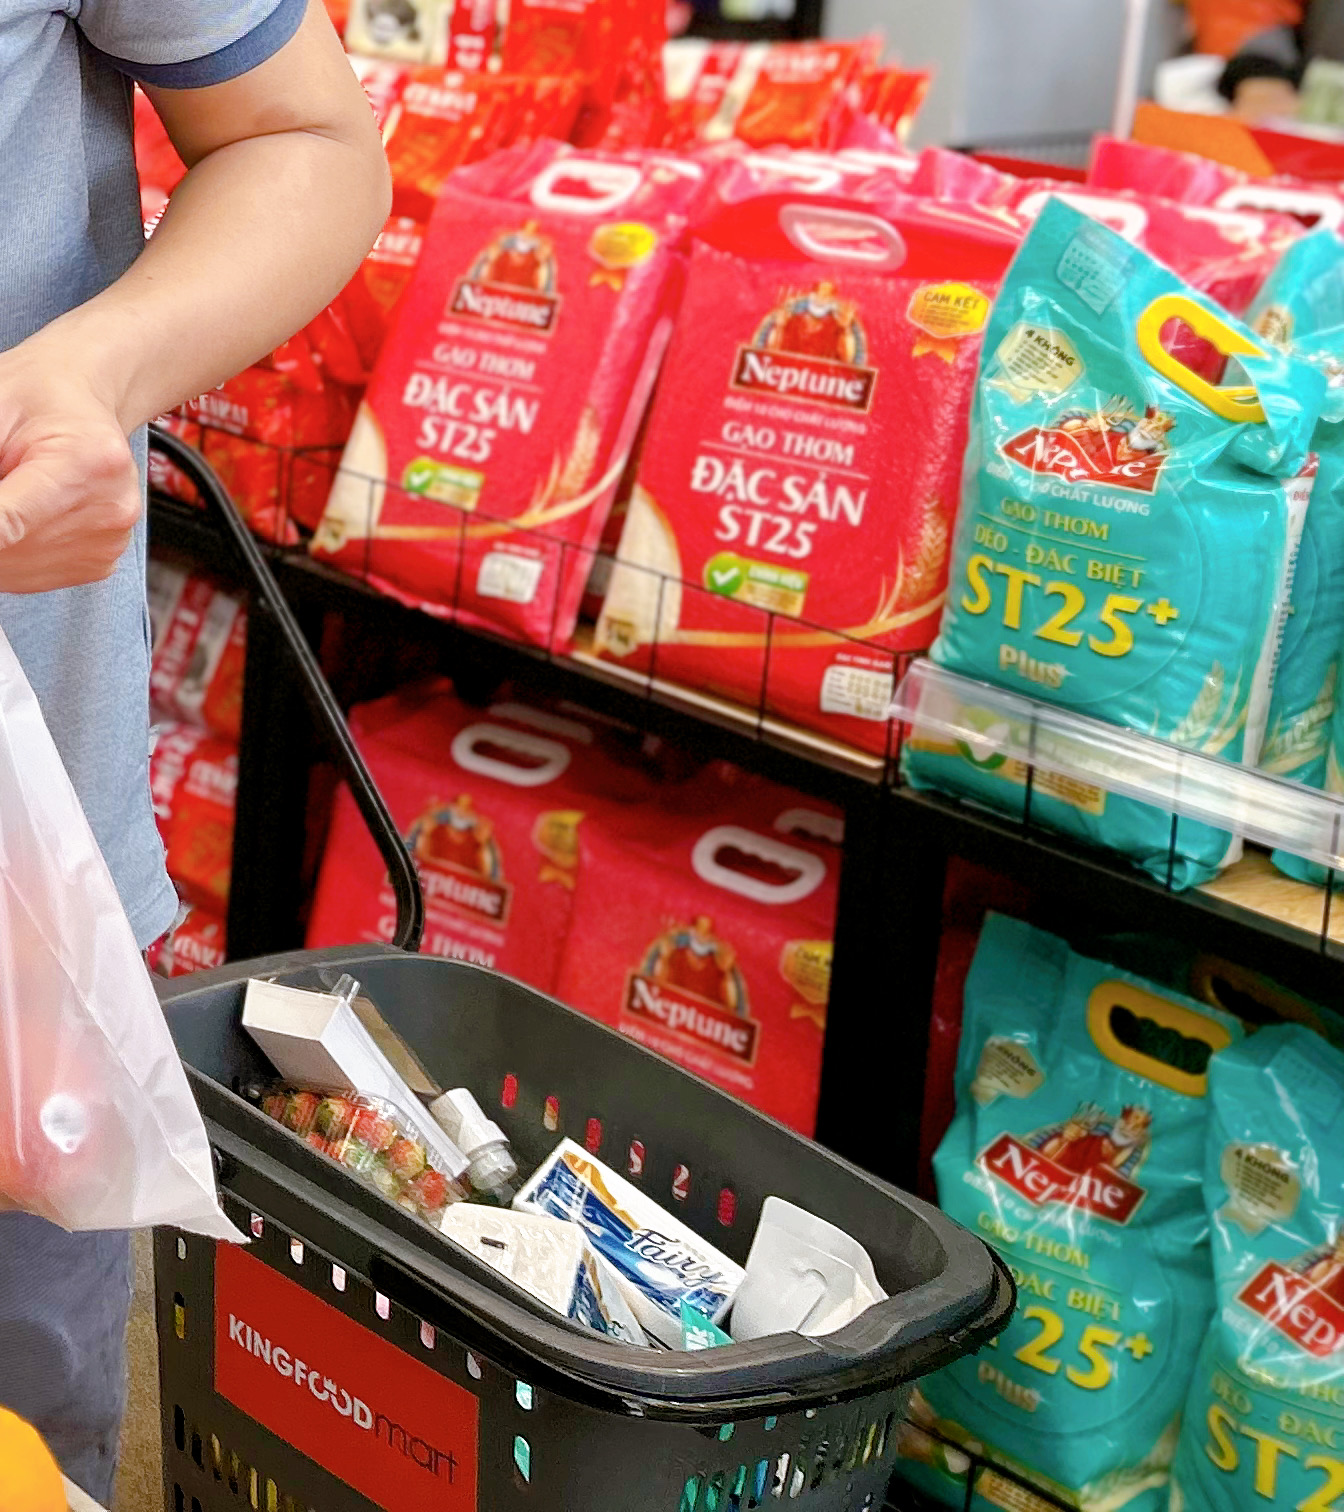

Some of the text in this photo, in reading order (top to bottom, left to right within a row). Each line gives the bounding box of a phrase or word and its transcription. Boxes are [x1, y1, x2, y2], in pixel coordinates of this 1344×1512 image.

[454, 281, 552, 328] Neptune
[401, 371, 541, 436] ĐẶC SẢN
[740, 350, 866, 403] Neptune
[415, 414, 498, 464] ST25
[721, 419, 855, 467] GẠO THƠM
[689, 454, 868, 528] ĐẶC SẢN
[1091, 493, 1151, 517] LƯỢNG
[713, 503, 819, 560] ST25
[1043, 509, 1110, 541] THƠM
[1025, 542, 1079, 575] ĐẶC
[1085, 558, 1147, 589] BIỆT
[418, 867, 503, 917] eptune
[632, 977, 750, 1053] Neptune
[623, 1227, 728, 1289] Fairy
[1254, 1270, 1344, 1348] Nep
[1012, 1305, 1154, 1391] 25+
[1204, 1402, 1344, 1512] ST2
